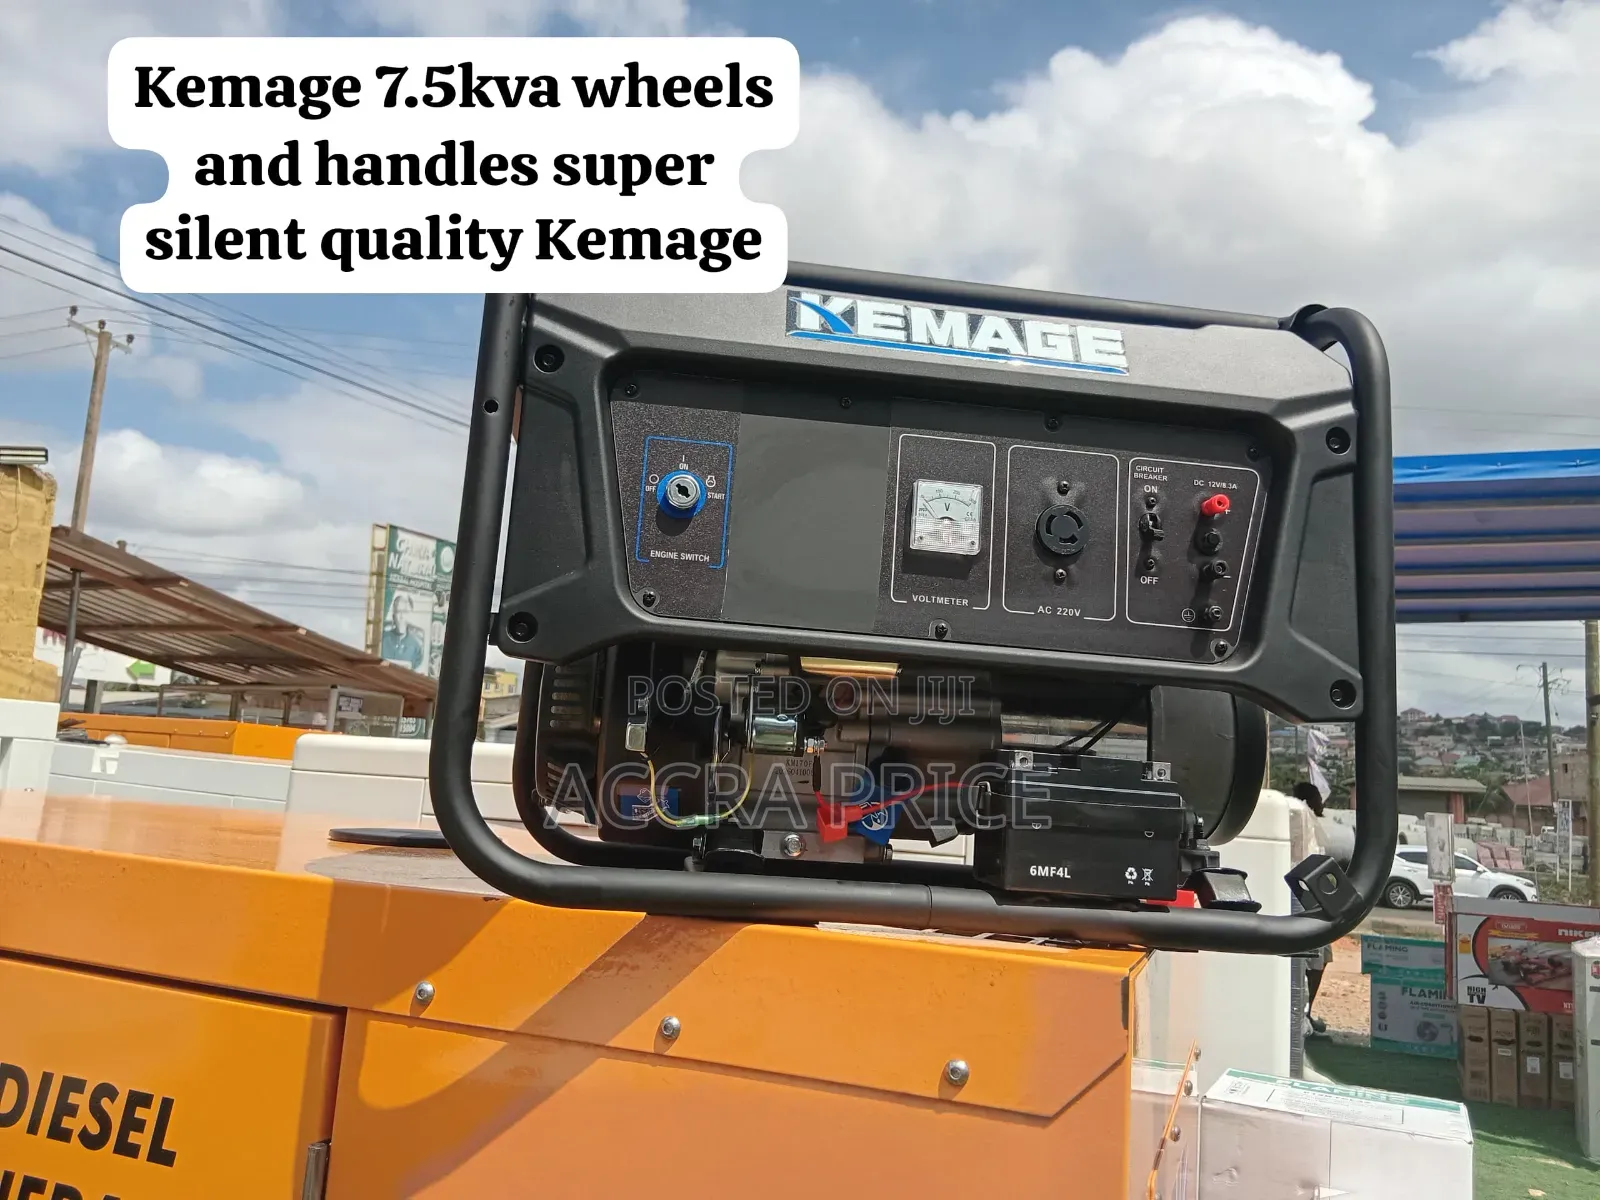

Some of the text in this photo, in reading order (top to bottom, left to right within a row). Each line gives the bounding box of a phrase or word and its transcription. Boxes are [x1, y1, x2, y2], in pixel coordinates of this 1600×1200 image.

[789, 290, 1127, 369] KEMAGE
[1135, 465, 1165, 474] CIRCUIT
[1133, 472, 1168, 482] BREAKER
[1193, 479, 1205, 487] DC
[645, 485, 657, 493] OFF
[1143, 484, 1158, 494] ON
[707, 492, 726, 500] START
[944, 502, 951, 512] V
[650, 550, 710, 562] ENGINE SWITCH
[1140, 576, 1159, 585] OFF
[912, 594, 969, 607] VOLTMETER
[1037, 605, 1081, 617] AC 220V
[1029, 865, 1072, 879] 6MF4L
[1468, 994, 1487, 1005] TV
[0, 1062, 177, 1168] DIESEL
